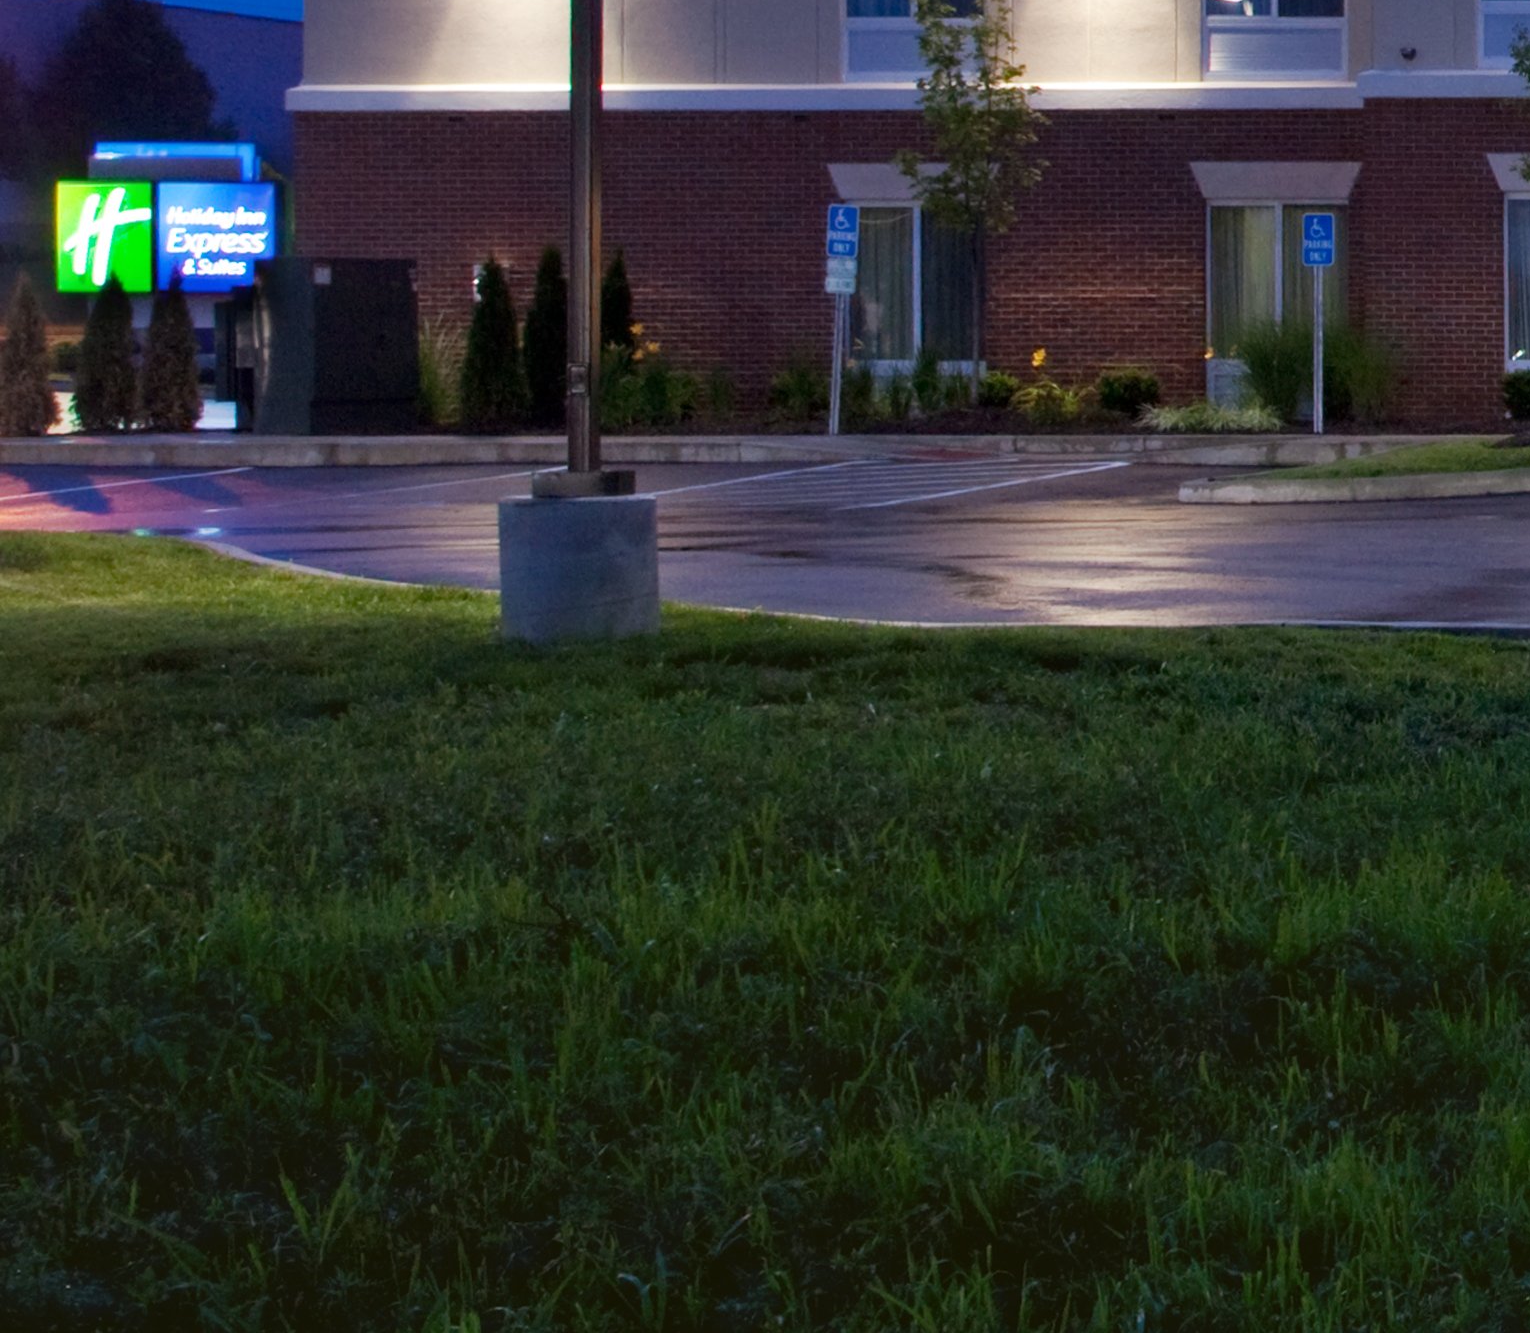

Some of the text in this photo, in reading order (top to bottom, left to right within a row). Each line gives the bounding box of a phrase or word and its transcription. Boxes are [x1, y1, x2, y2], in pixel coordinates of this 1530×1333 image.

[166, 205, 267, 230] Holiday Inn
[166, 227, 269, 259] Express
[182, 257, 246, 275] & Suites
